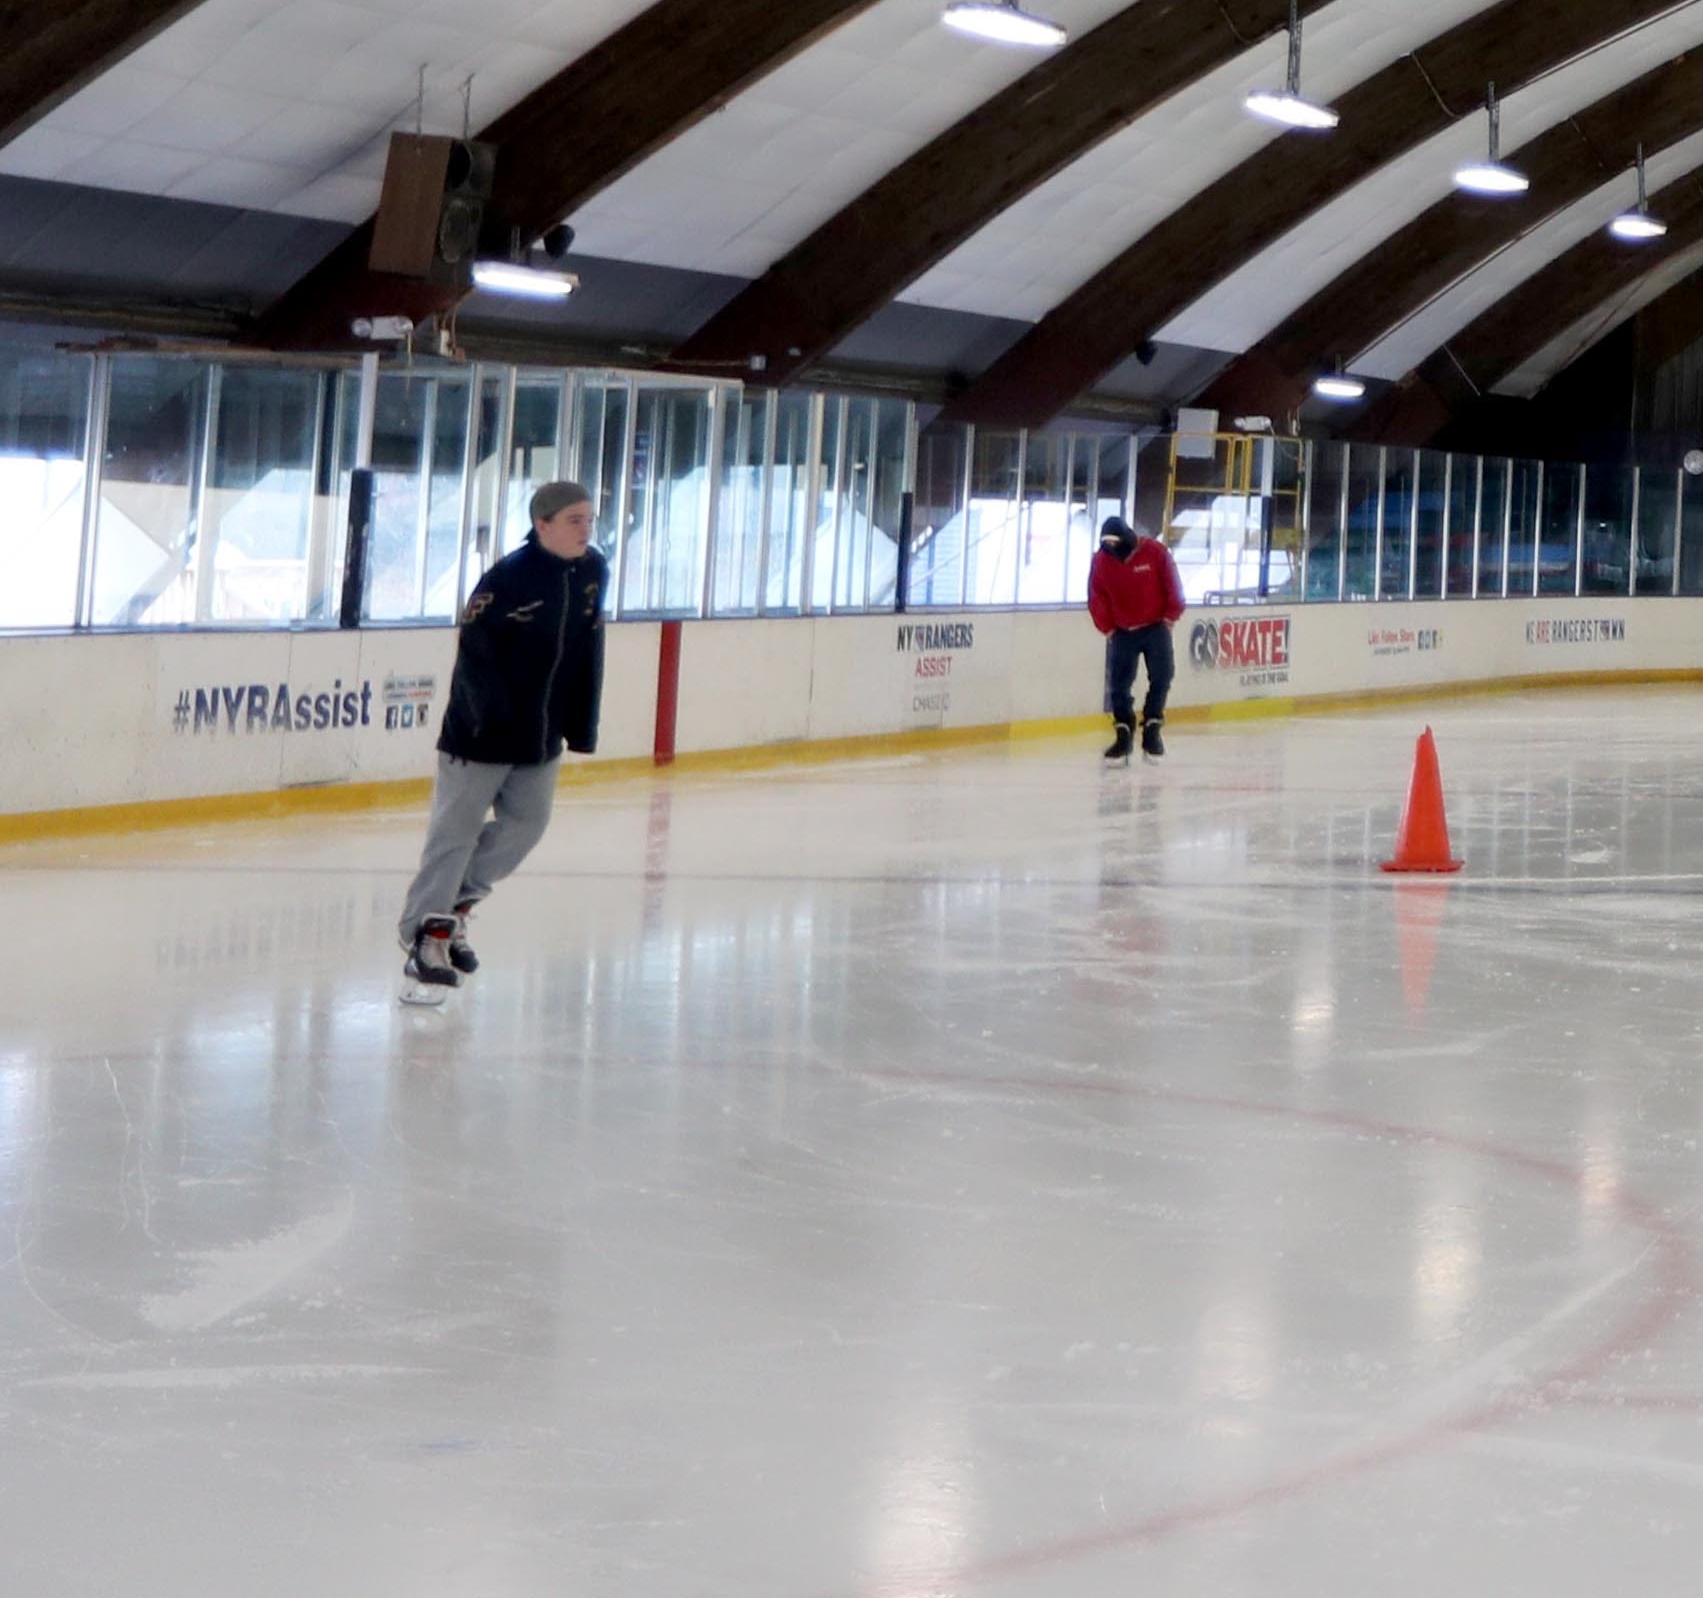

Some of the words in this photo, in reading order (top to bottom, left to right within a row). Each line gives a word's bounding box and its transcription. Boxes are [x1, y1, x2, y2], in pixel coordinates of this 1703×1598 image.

[897, 625, 914, 651] NY
[925, 623, 975, 650] RANGERS
[1537, 619, 1551, 643] ARE
[915, 656, 953, 678] ASSIST
[173, 679, 373, 735] #NYRAssist
